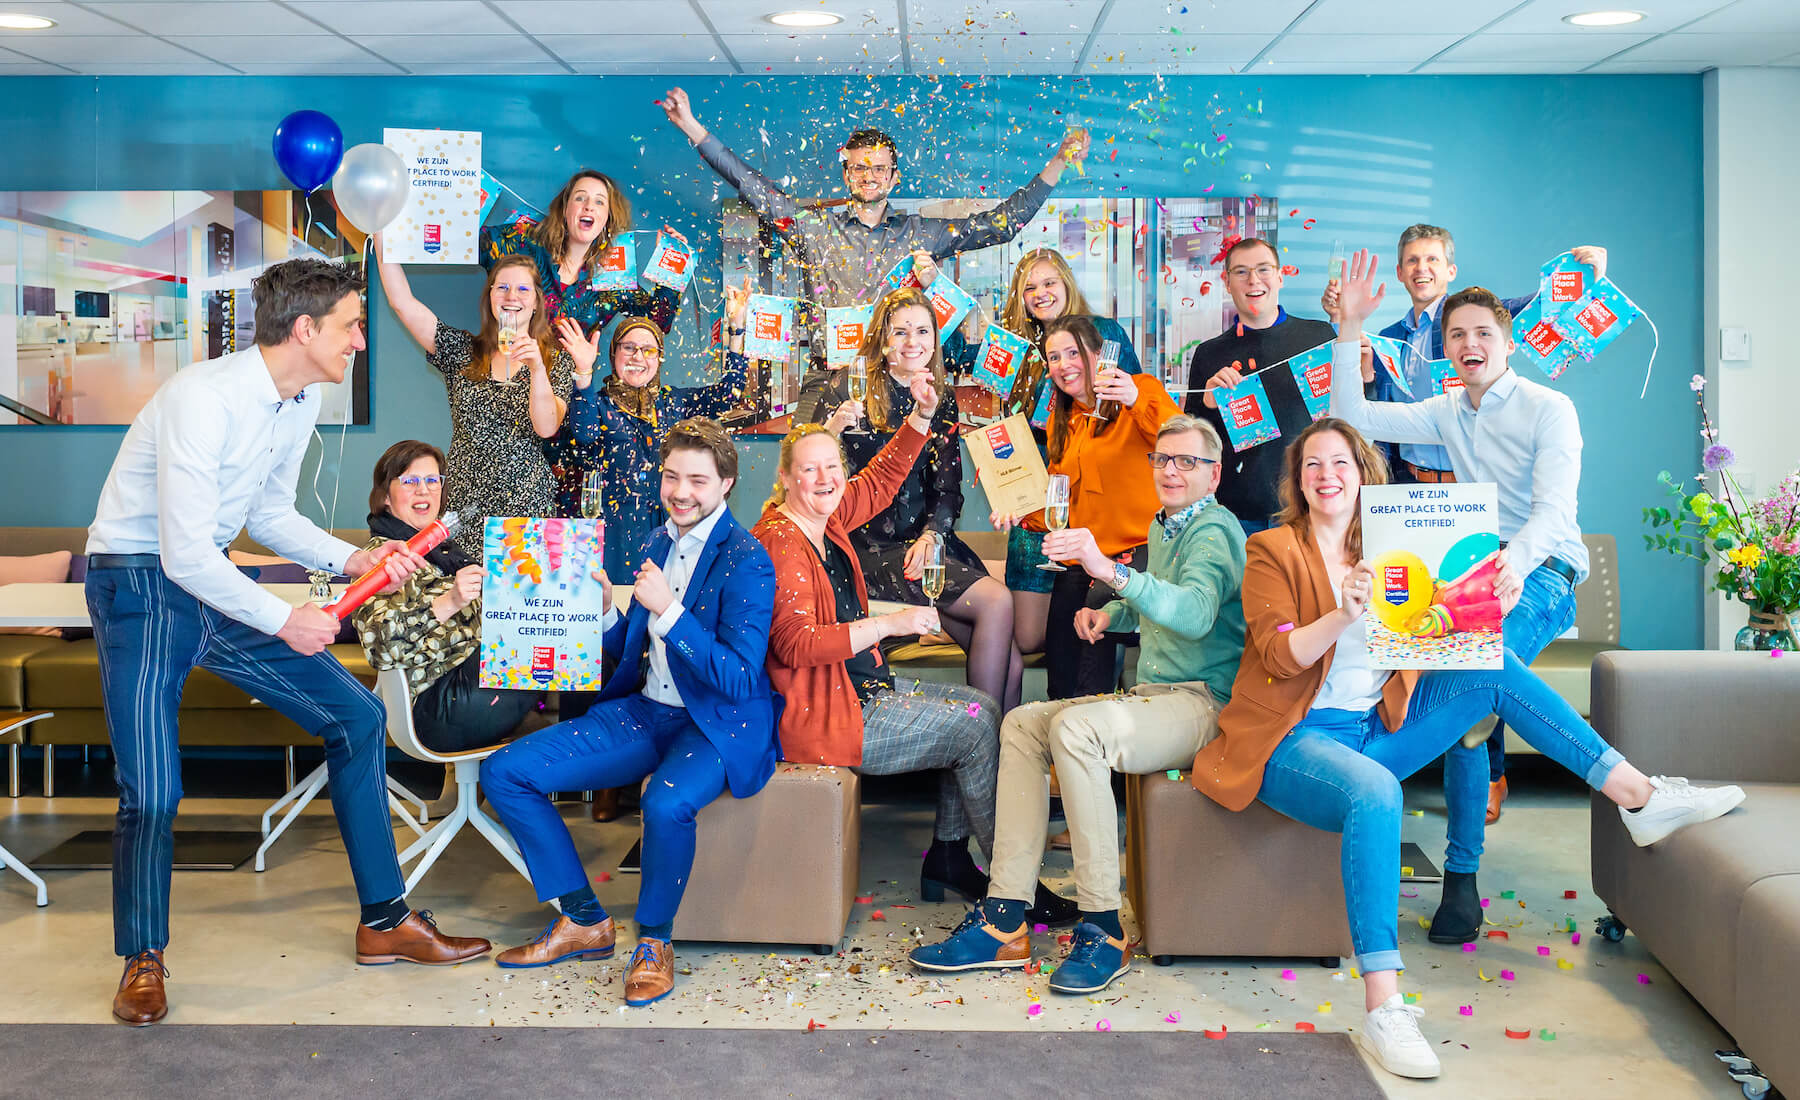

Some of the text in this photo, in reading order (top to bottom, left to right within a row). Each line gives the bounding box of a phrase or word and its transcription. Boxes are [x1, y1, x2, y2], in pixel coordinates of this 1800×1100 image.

[413, 168, 437, 176] PLACE
[412, 179, 452, 188] CERTIFIED!
[934, 295, 951, 311] Great
[1583, 309, 1591, 319] To
[1592, 300, 1611, 319] Great
[1526, 324, 1544, 341] Great
[1530, 329, 1548, 345] Place
[1535, 342, 1544, 350] To
[988, 350, 1005, 363] Place
[990, 345, 1008, 358] Great
[1306, 366, 1326, 378] Great
[1309, 373, 1328, 384] Place
[1311, 383, 1320, 391] To
[1231, 398, 1250, 409] Great
[1232, 404, 1252, 414] Place
[1235, 414, 1243, 422] To
[1408, 490, 1449, 499] WE ZIJN
[1370, 504, 1487, 514] GREAT PLACE TO WORK
[1404, 519, 1455, 528] CERTIFIED!
[524, 598, 564, 608] WE ZIJN
[485, 611, 599, 623] GREAT PLACE TO WORK
[518, 626, 568, 637] CERTIFIED!
